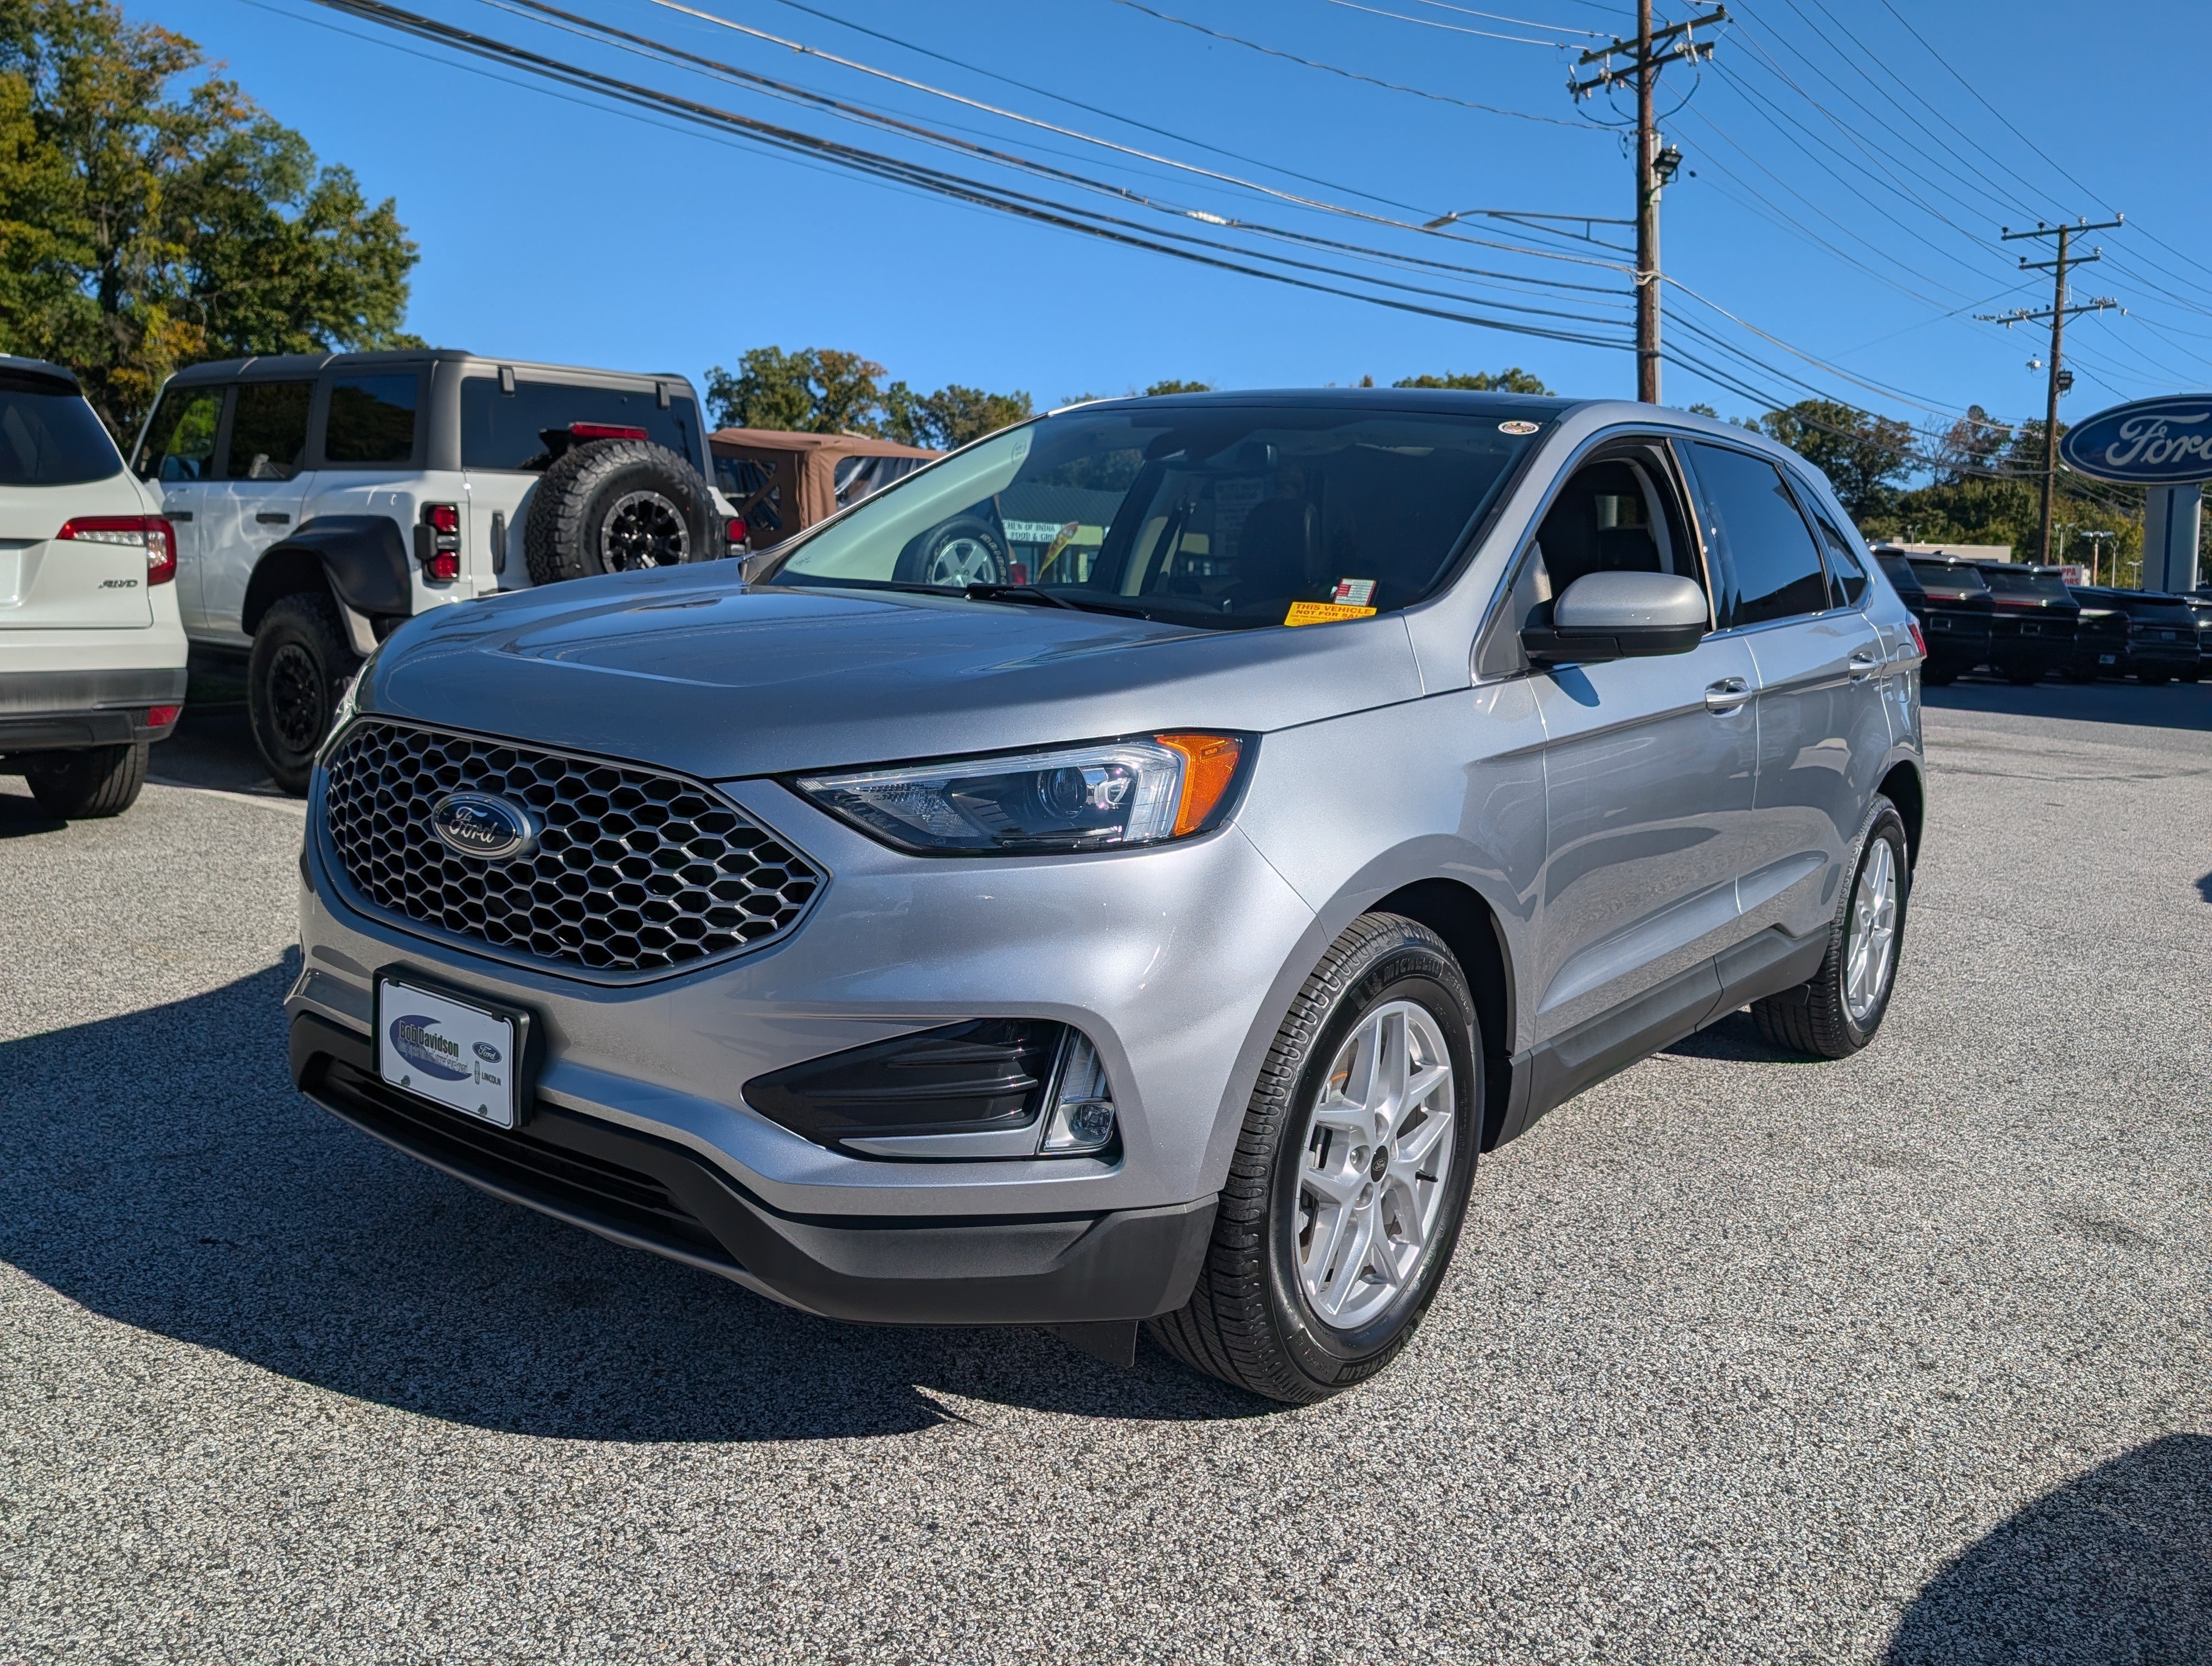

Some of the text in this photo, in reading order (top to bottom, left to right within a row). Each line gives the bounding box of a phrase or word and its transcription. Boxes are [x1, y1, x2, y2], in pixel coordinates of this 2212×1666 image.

[1011, 532, 1030, 540] FOOD
[98, 579, 139, 589] AWD
[1324, 606, 1372, 615] VEHICLE
[449, 806, 498, 843] Ford
[1384, 956, 1441, 983] MICHELIN
[1445, 972, 1472, 1014] DEFENDER
[400, 1020, 417, 1043] Bob
[417, 1026, 459, 1058] Davidson
[478, 1045, 496, 1060] Ford
[481, 1071, 501, 1087] LINCOLN
[1337, 1338, 1401, 1381] MICHELIN
